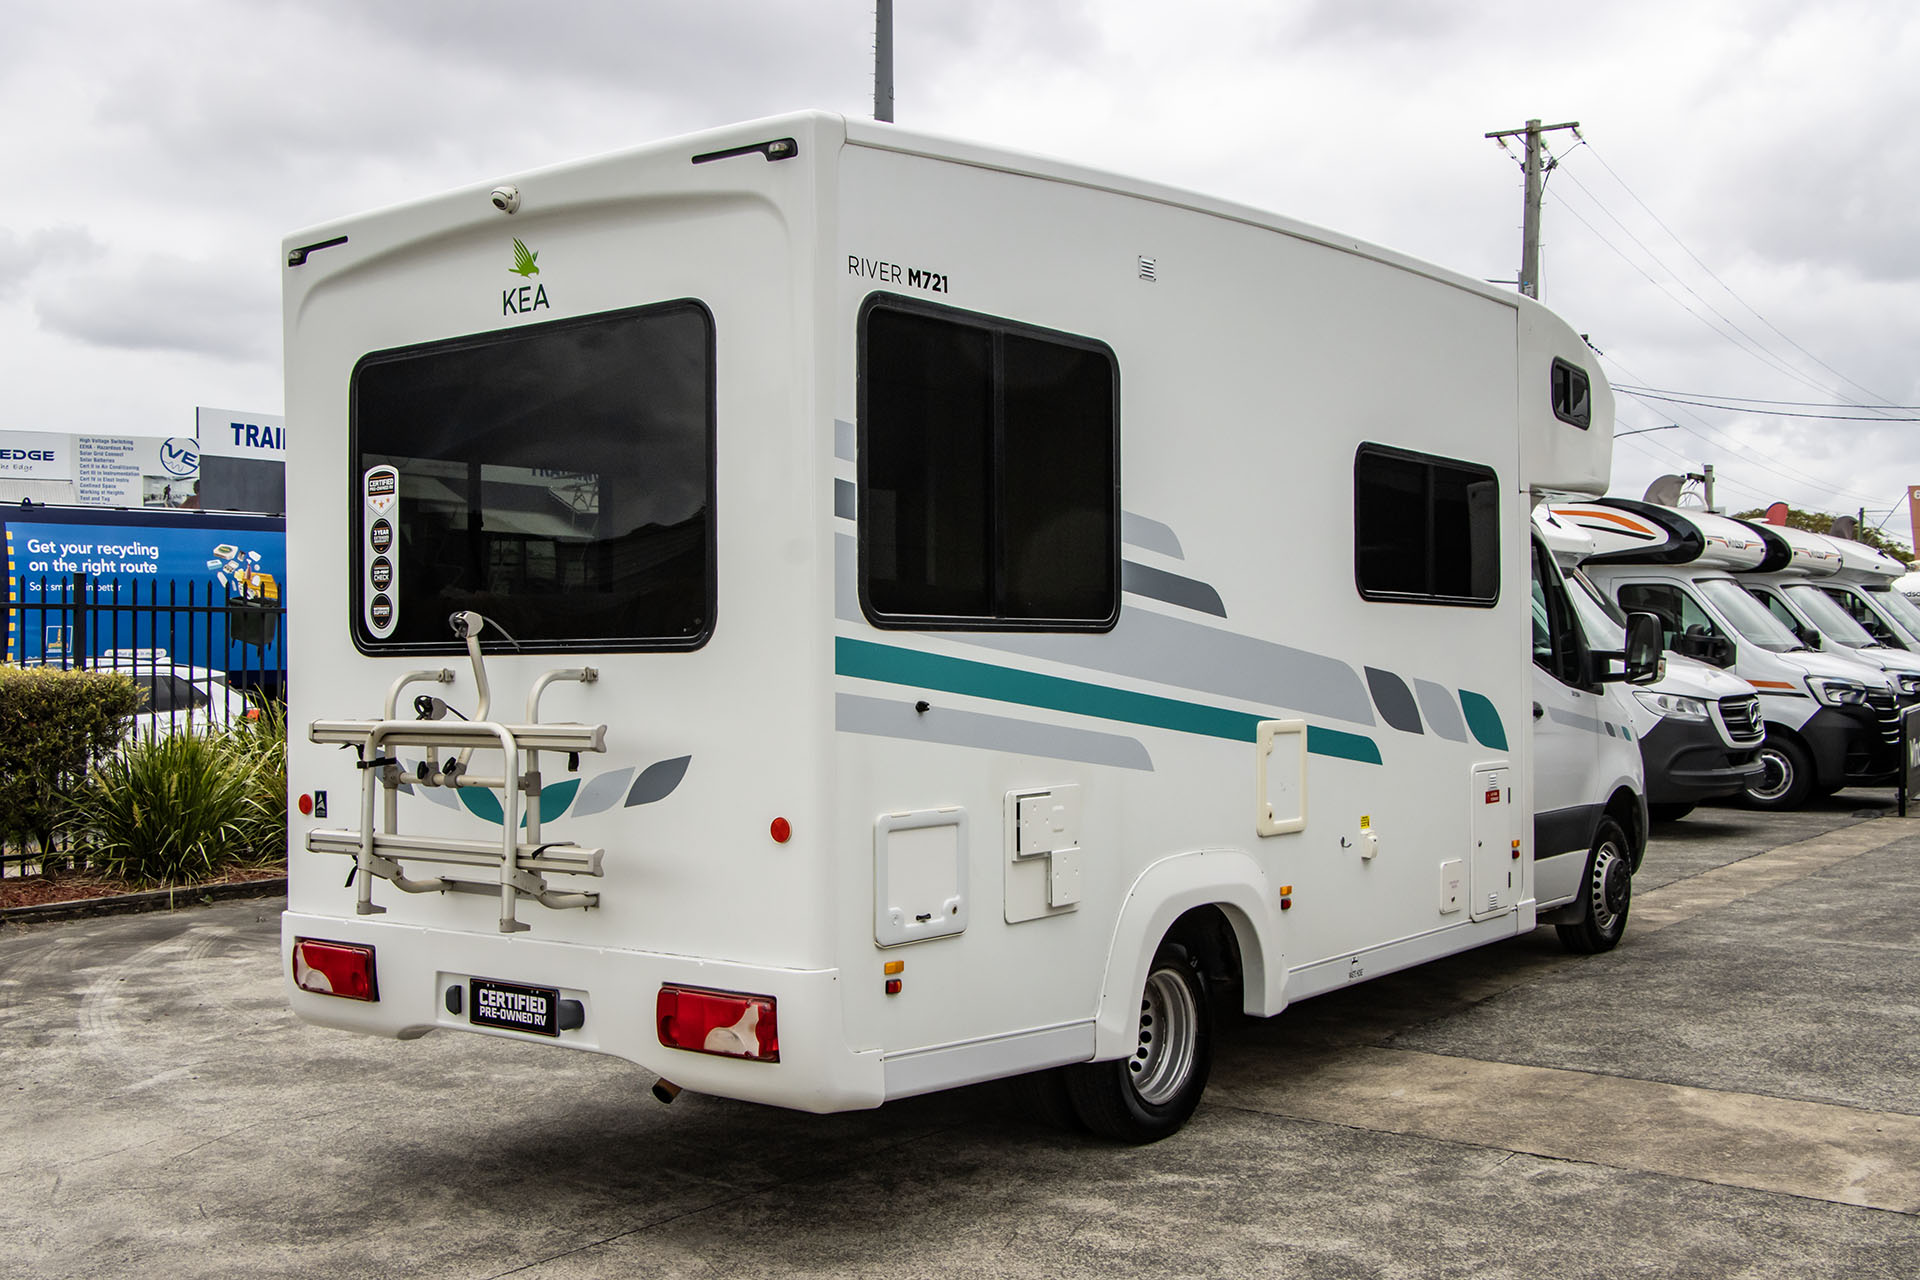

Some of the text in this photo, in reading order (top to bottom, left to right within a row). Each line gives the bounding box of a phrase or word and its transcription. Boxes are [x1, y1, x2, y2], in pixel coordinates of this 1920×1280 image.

[848, 255, 948, 294] RIVER M721
[503, 283, 550, 316] KEA
[230, 422, 285, 450] TRAI
[369, 478, 394, 488] CERTIFIED
[27, 539, 159, 560] Get your recycling
[28, 557, 157, 576] on the right route
[29, 581, 49, 591] Sot
[50, 583, 75, 591] smrt
[479, 988, 547, 1014] CERTIFIED
[479, 1005, 547, 1026] PRE-OWNED RV
